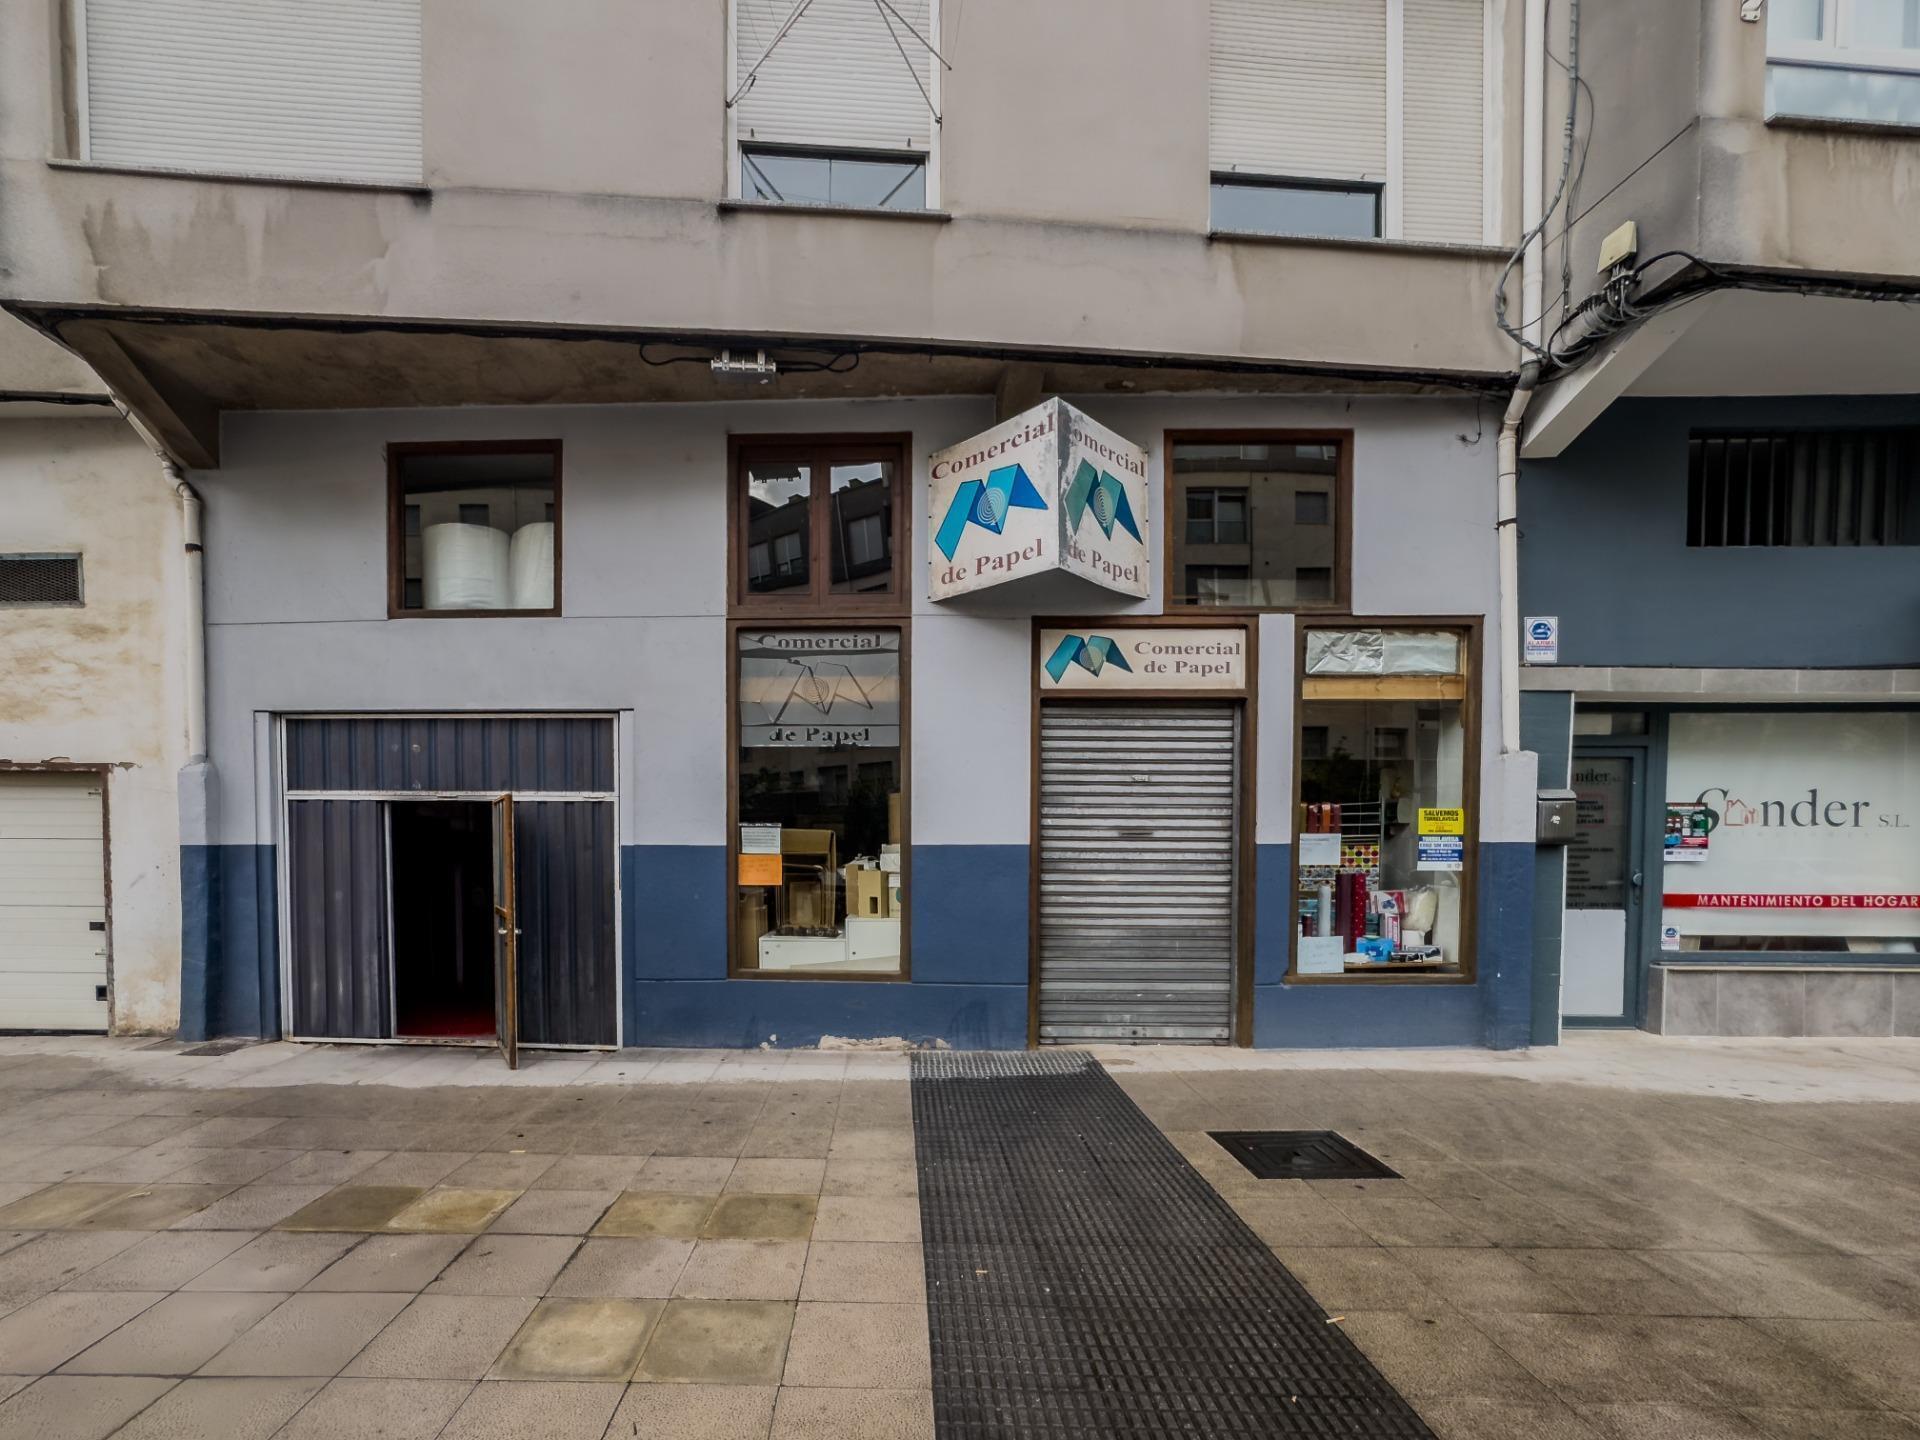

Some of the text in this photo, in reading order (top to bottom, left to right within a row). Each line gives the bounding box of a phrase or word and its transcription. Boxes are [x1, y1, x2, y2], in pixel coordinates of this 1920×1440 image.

[931, 412, 1056, 480] Comercial
[1071, 427, 1145, 478] omercial
[941, 538, 1043, 585] de Papel
[1068, 541, 1139, 583] de Papel
[759, 634, 881, 650] Comercial
[1134, 641, 1241, 655] Comercial
[1144, 660, 1231, 677] de Papel
[769, 728, 870, 745] de Papel
[1697, 895, 1919, 907] MANTENIMIENTO DEL HOGAR
